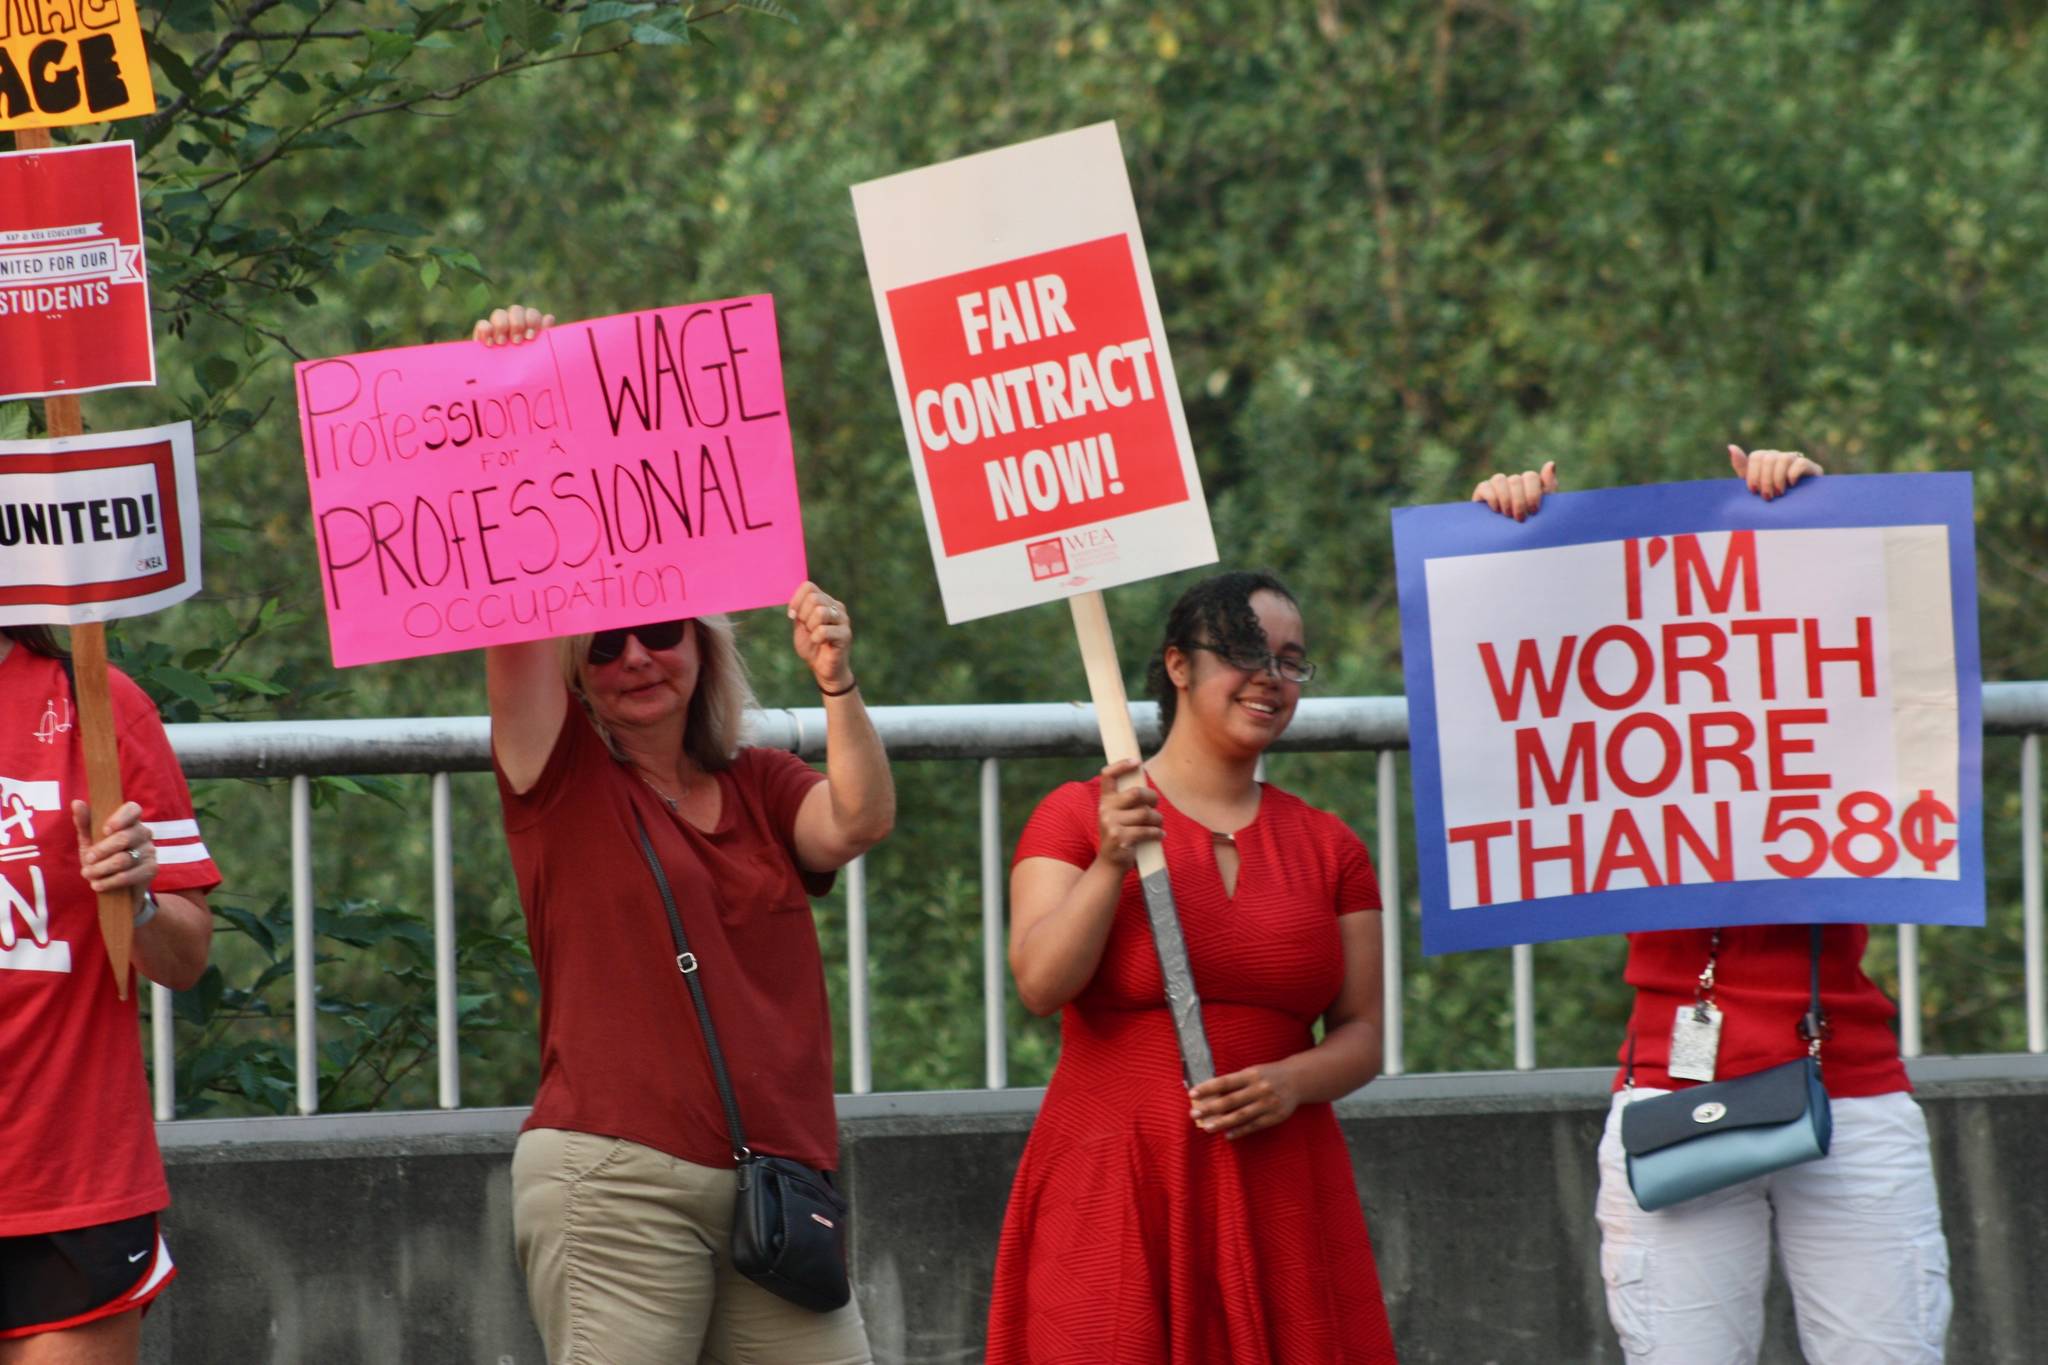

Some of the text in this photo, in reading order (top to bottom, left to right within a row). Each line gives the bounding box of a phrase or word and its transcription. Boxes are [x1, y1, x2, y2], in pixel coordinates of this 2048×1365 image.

[0, 281, 110, 315] STUDENTS
[50, 255, 75, 272] FOR
[81, 251, 108, 268] OUR
[957, 273, 1076, 356] FAIR
[302, 302, 781, 479] Professional WAGE
[914, 337, 1155, 451] CONTRACT
[0, 494, 157, 547] UNITED!
[984, 432, 1124, 522] NOW!
[1065, 526, 1115, 551] WEA
[1622, 529, 1761, 620] I'M
[1477, 616, 1877, 722] WORTH
[1514, 708, 1832, 809] MORE
[1448, 789, 1958, 906] THAN 58¢
